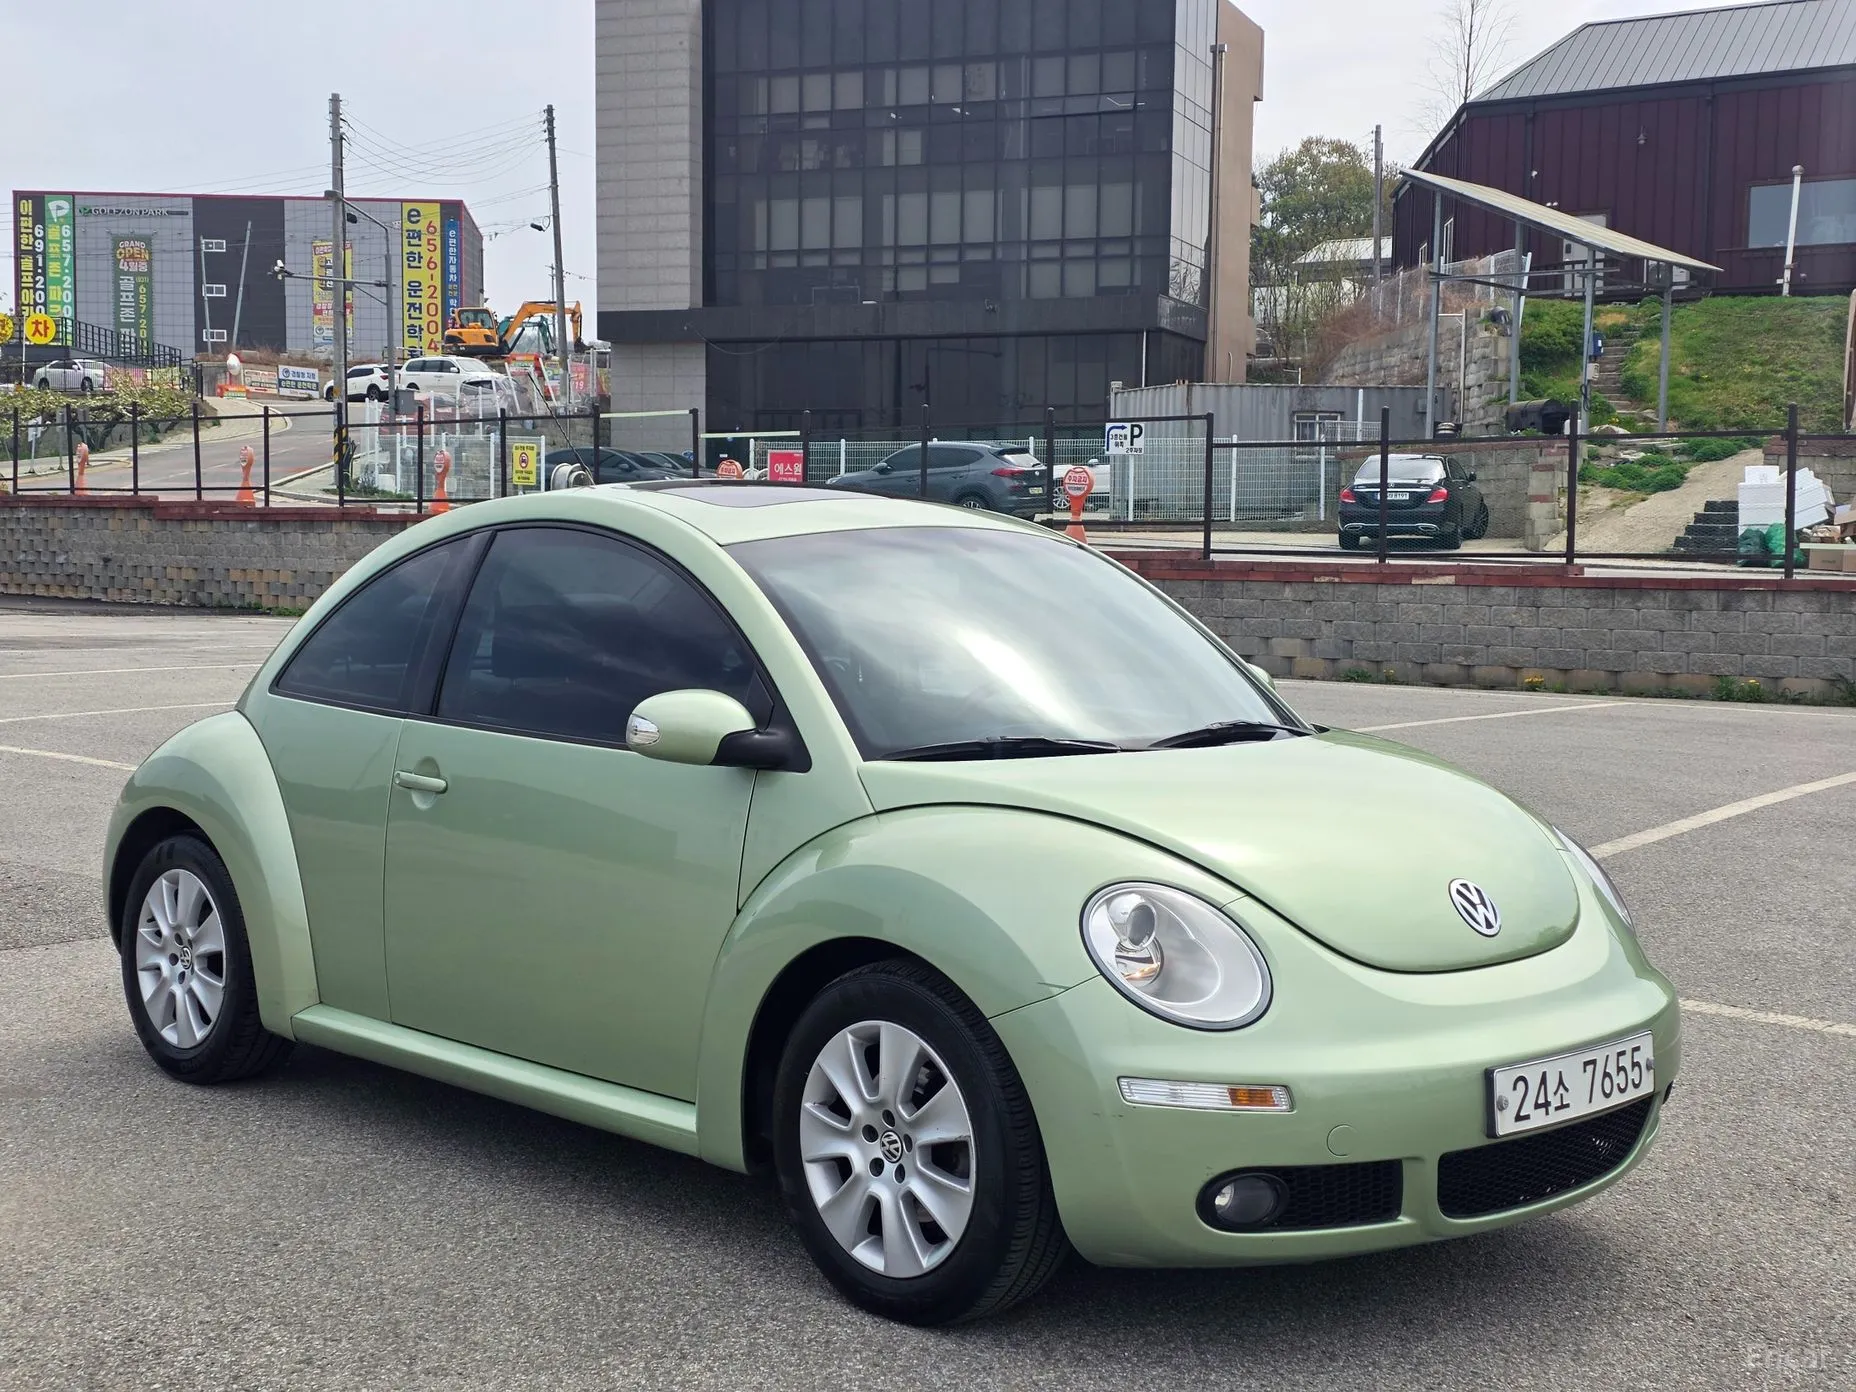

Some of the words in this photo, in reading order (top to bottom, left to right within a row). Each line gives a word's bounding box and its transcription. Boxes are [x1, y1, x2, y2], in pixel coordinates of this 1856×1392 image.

[119, 240, 146, 249] GRAND
[406, 208, 424, 269] e편한
[115, 247, 149, 260] OPEN
[425, 220, 440, 353] 656-2004
[31, 318, 50, 338] 차
[1130, 423, 1143, 446] P
[1512, 1070, 1571, 1123] 24소
[1582, 1045, 1643, 1105] 7655
